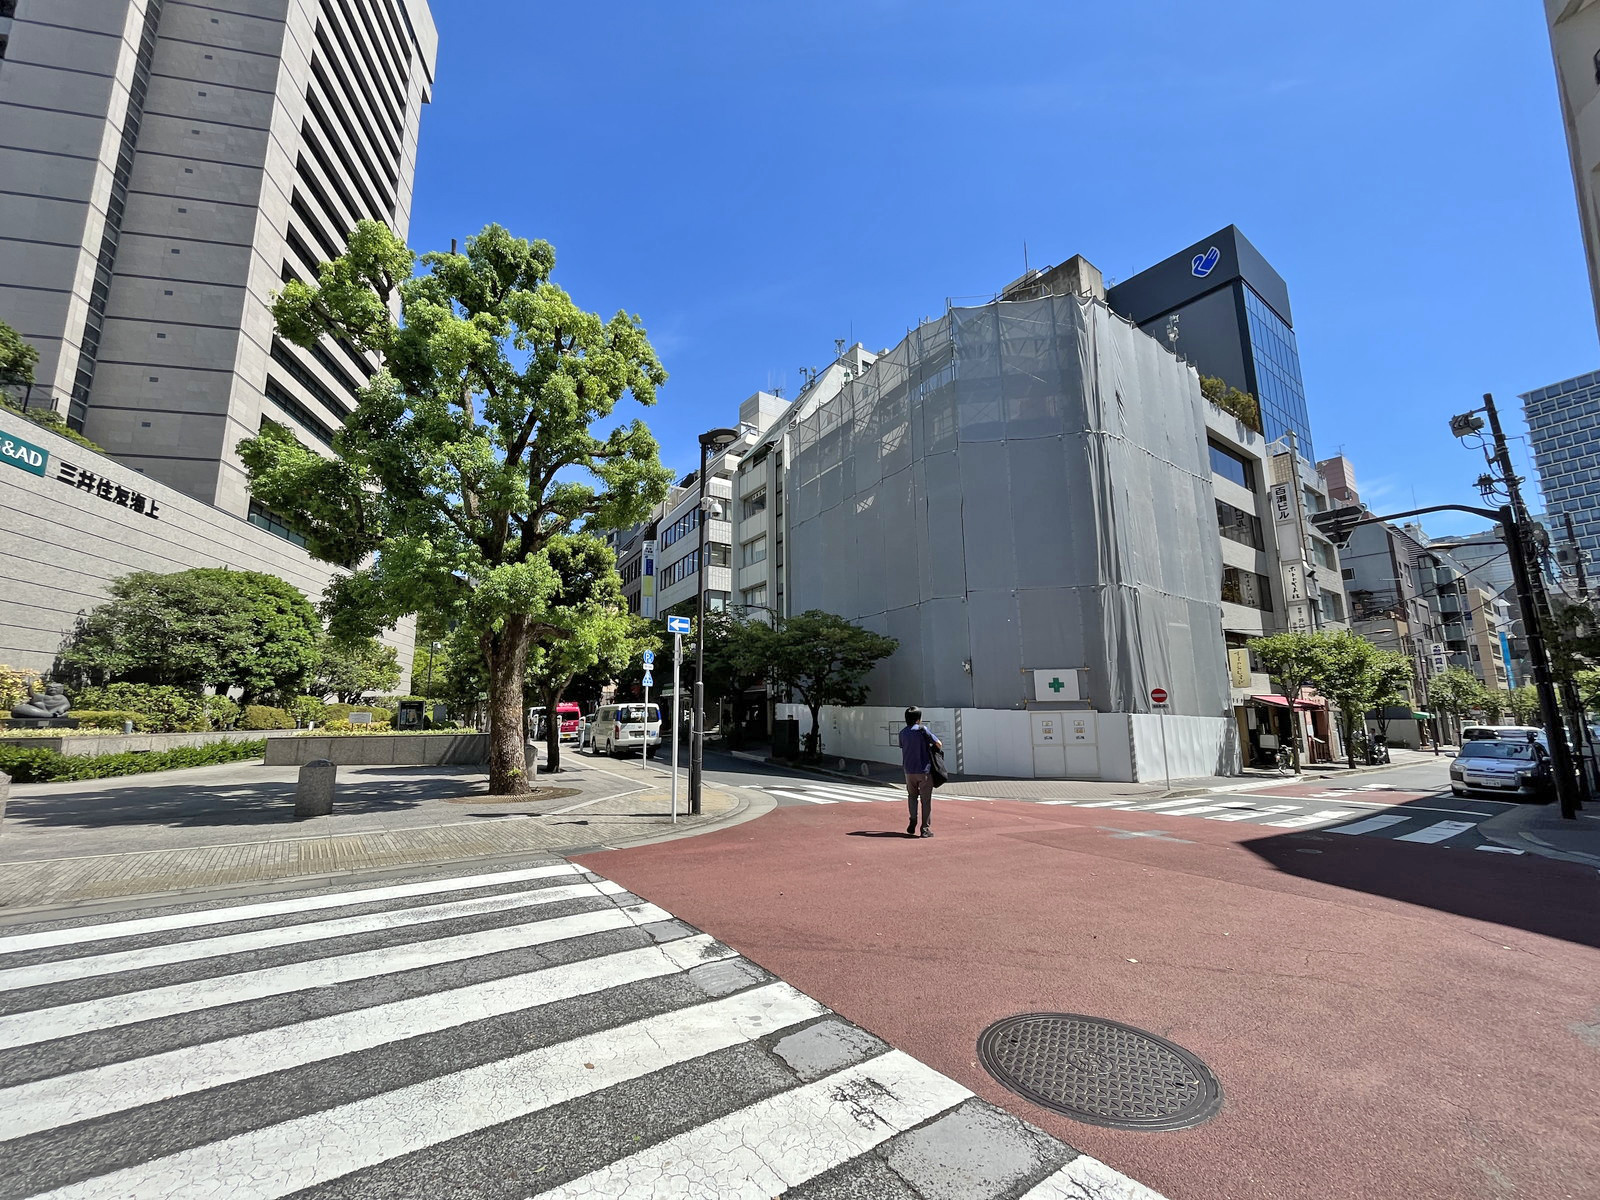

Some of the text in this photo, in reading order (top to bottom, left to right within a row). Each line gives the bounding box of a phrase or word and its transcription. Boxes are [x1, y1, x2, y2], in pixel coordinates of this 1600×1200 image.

[0, 437, 43, 467] &AD
[56, 462, 160, 519] 三井住友海上
[1275, 486, 1290, 520] 百瀬ビル
